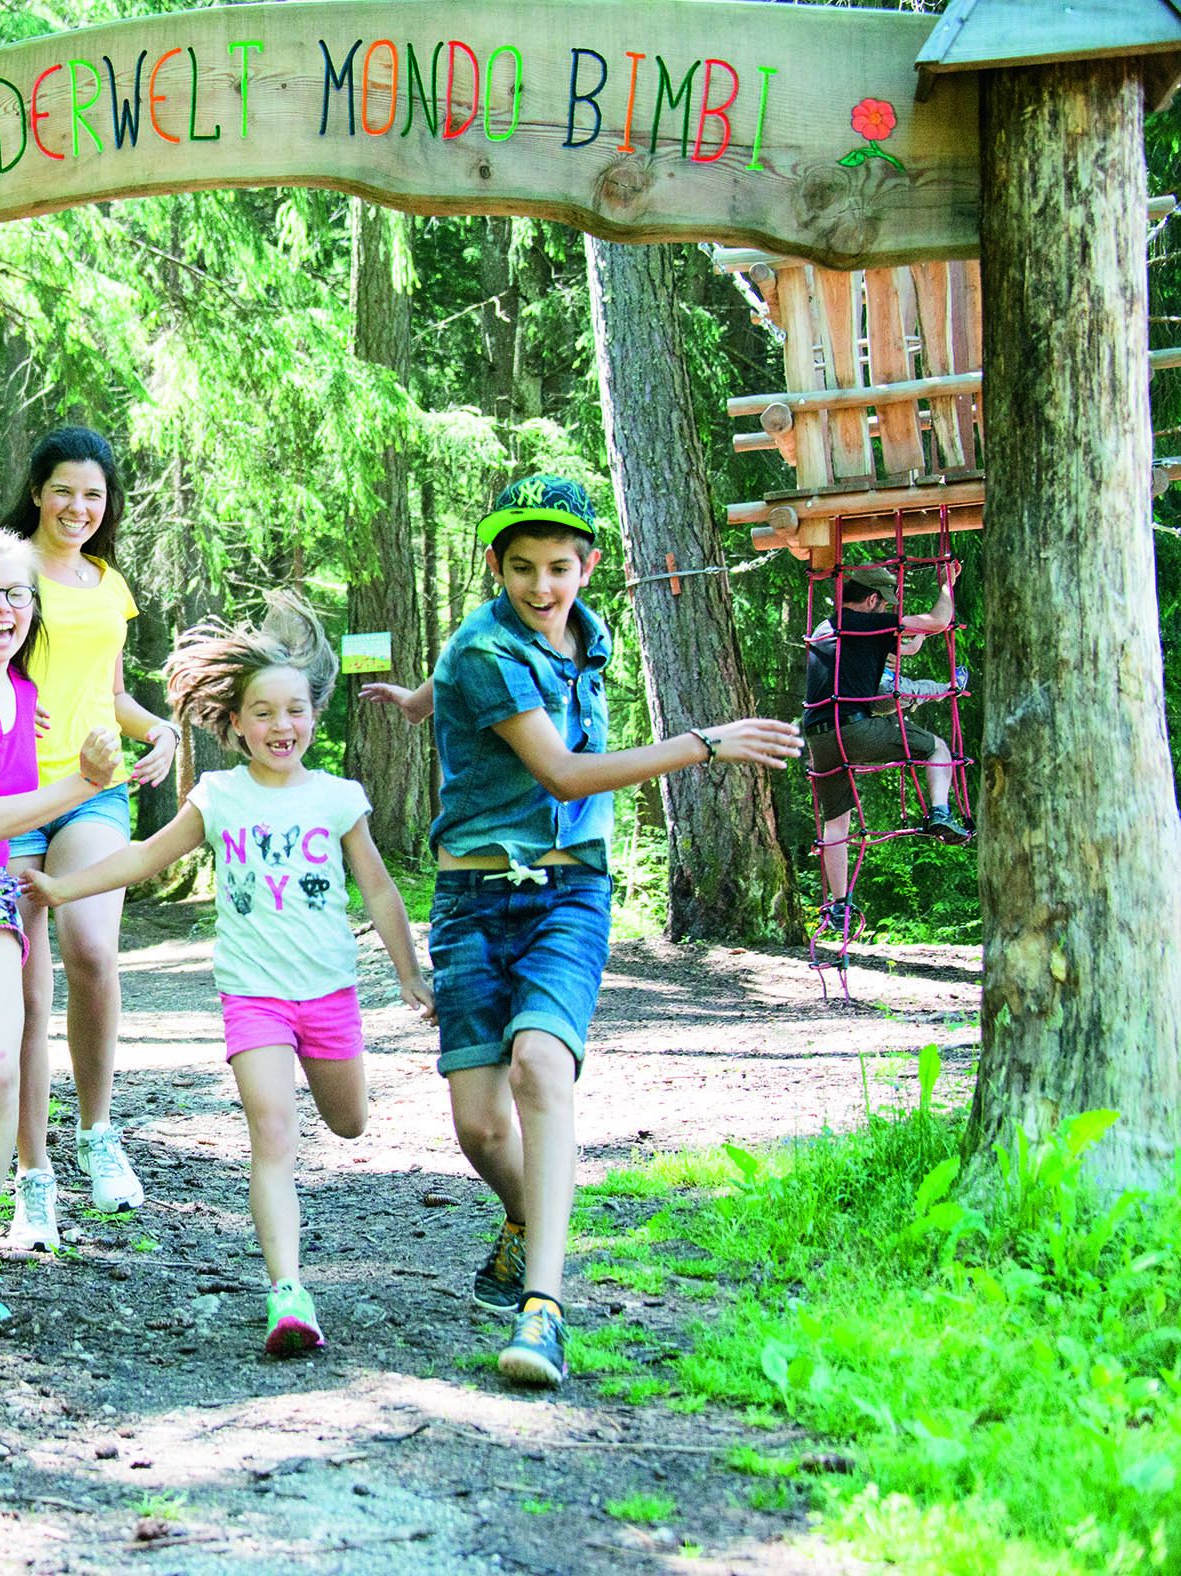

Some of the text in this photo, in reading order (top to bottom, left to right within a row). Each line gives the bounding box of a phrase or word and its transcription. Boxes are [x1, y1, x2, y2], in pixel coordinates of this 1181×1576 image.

[318, 38, 524, 142] MONDO
[562, 47, 779, 172] BIMBI
[265, 875, 290, 911] Y
